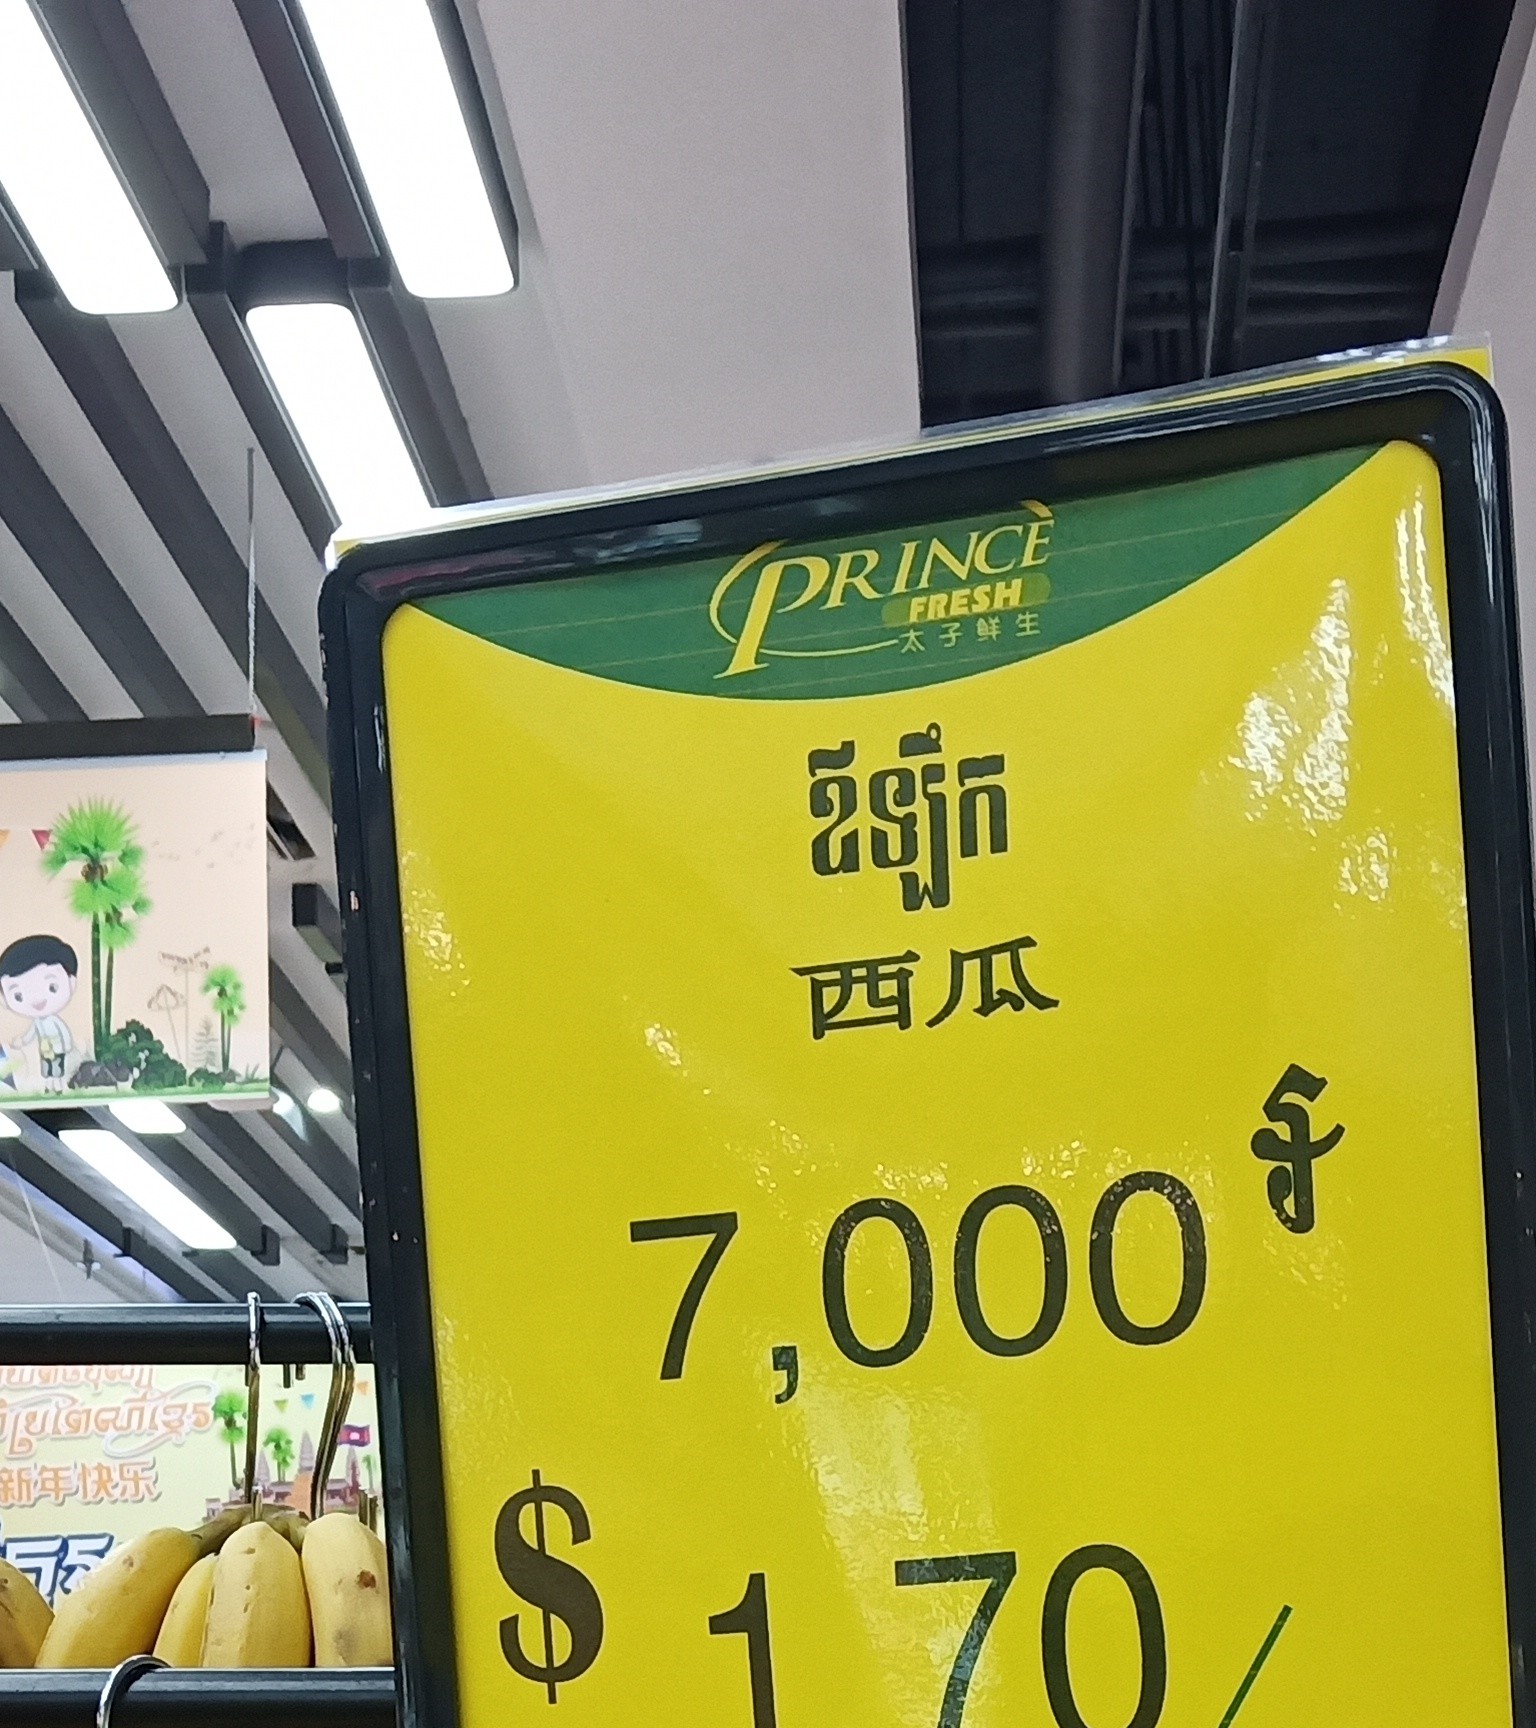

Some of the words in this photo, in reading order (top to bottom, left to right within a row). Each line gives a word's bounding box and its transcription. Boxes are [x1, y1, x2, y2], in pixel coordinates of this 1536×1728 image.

[898, 612, 1042, 654] 太子鲜生
[909, 579, 1023, 623] FRESH
[789, 934, 1061, 1041] 西瓜
[629, 1169, 1207, 1404] 7,000
[493, 1467, 605, 1706] $
